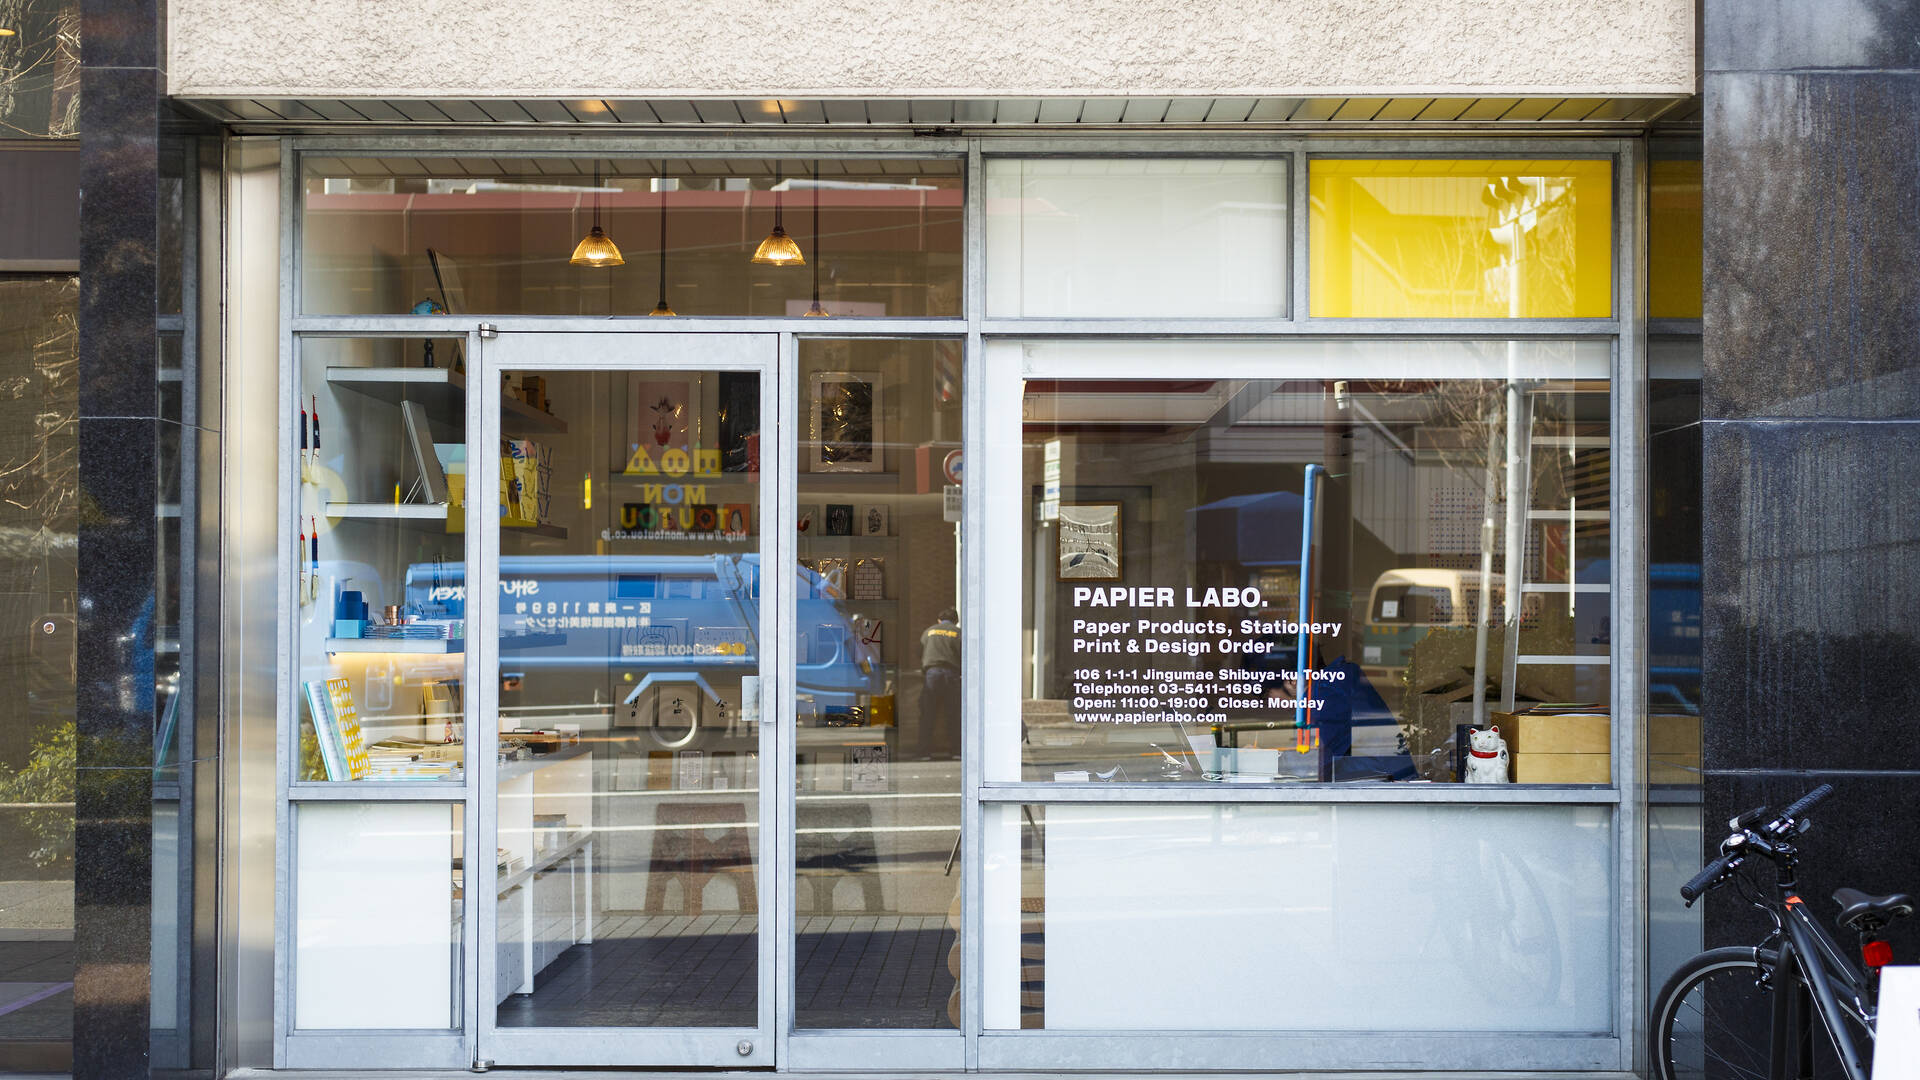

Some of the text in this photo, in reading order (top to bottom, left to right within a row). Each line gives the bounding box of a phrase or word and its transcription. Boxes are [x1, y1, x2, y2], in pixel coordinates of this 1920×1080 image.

[1074, 587, 1268, 608] PAPIER LABO.
[1073, 620, 1342, 638] Paper Products, Stationery
[1073, 638, 1275, 657] Print & Design Order
[1073, 669, 1346, 683] 106 1-1-1 Jingumae Shibuya-ku Tokyo
[1073, 683, 1263, 696] Telephone: 03-5411-1696
[1073, 697, 1325, 711] Open: 11:00-19:00 Close: Monday
[1073, 711, 1227, 725] www.papierlabo.com
